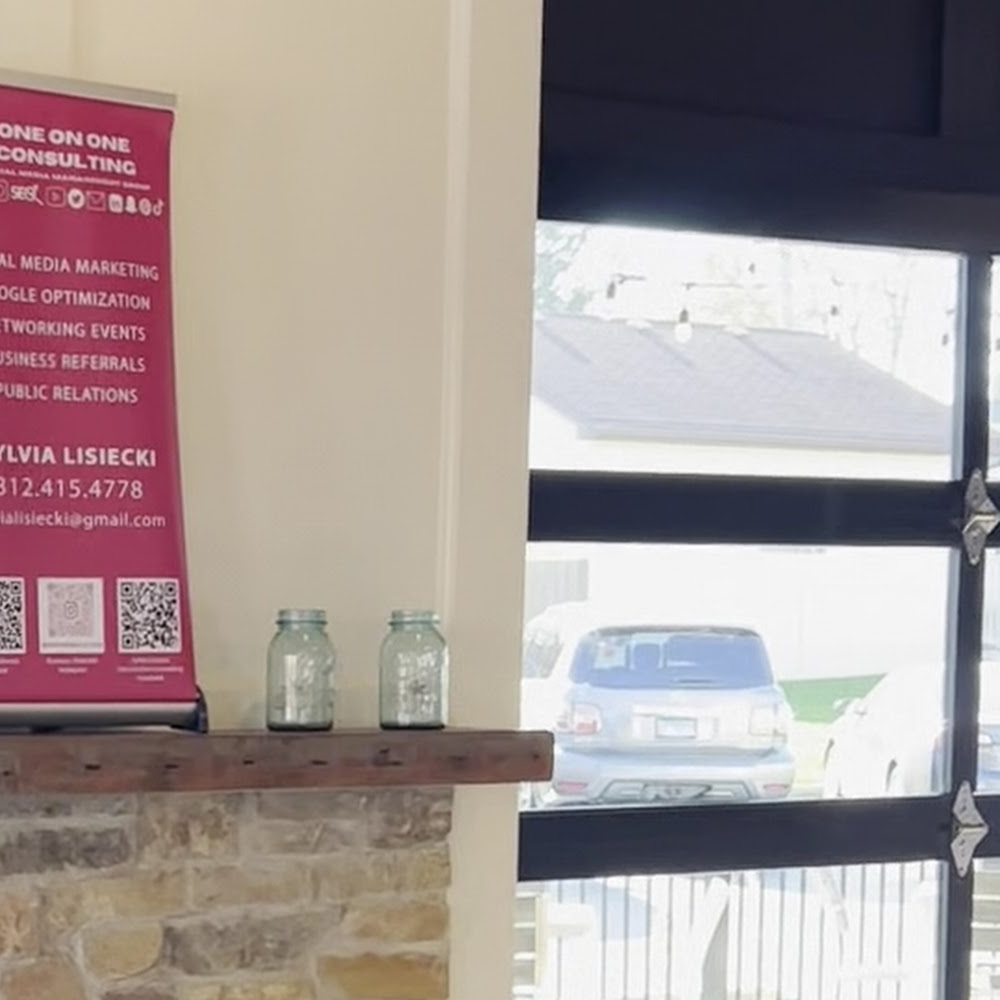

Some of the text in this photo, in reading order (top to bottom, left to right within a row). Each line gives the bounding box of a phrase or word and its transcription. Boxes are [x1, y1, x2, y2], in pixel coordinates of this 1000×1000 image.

[48, 129, 84, 147] ON
[86, 133, 131, 153] ONE
[20, 254, 71, 273] MEDIA
[75, 259, 160, 281] MARKETING
[41, 289, 151, 310] OPTIMIZATION
[91, 325, 146, 342] EVENTS
[61, 354, 146, 373] REFERRALS
[53, 385, 139, 404] RELATIONS
[63, 447, 156, 467] LISIECKI
